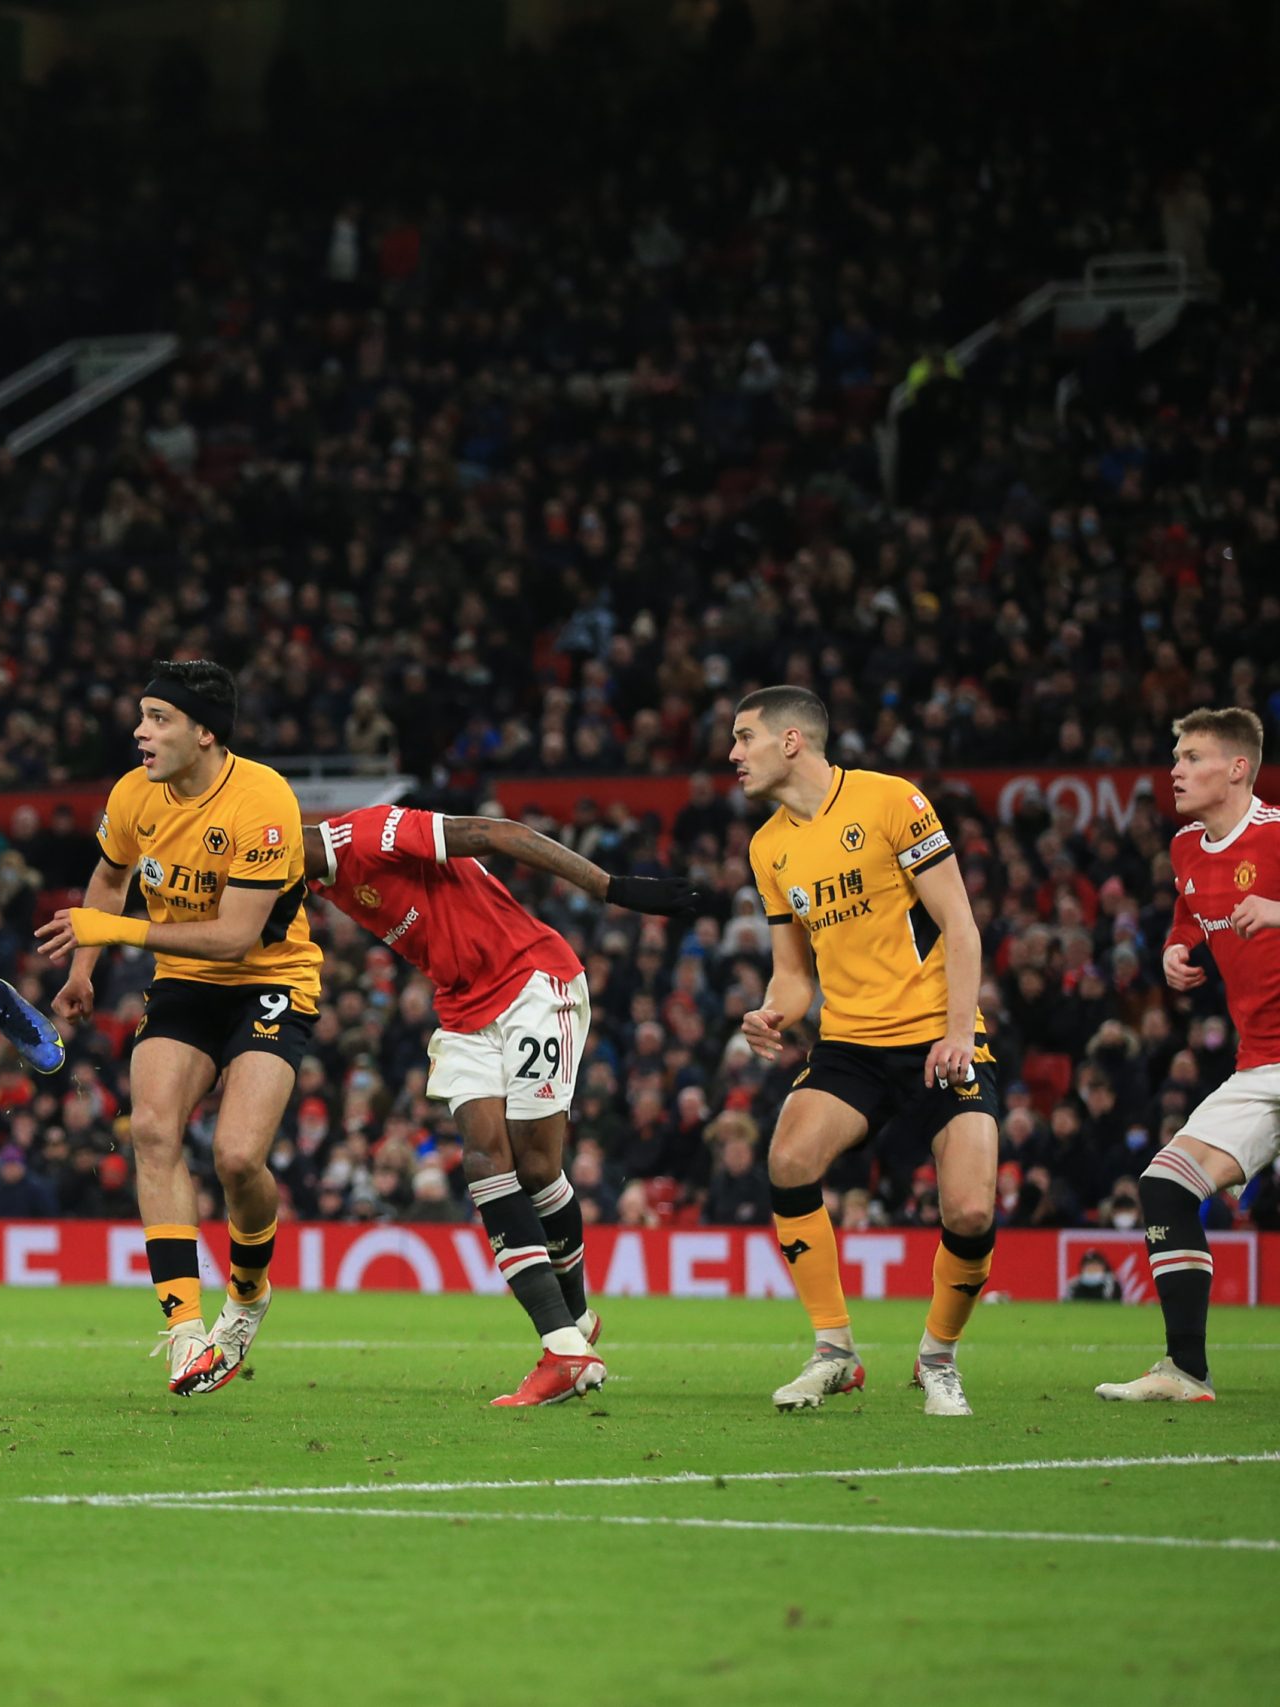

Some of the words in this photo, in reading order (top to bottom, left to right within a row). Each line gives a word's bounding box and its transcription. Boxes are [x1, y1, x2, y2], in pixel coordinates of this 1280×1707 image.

[381, 805, 406, 852] KOHLE
[168, 864, 218, 894] 万博
[812, 868, 864, 907] 万博
[260, 993, 289, 1020] 9
[515, 1036, 560, 1080] 29
